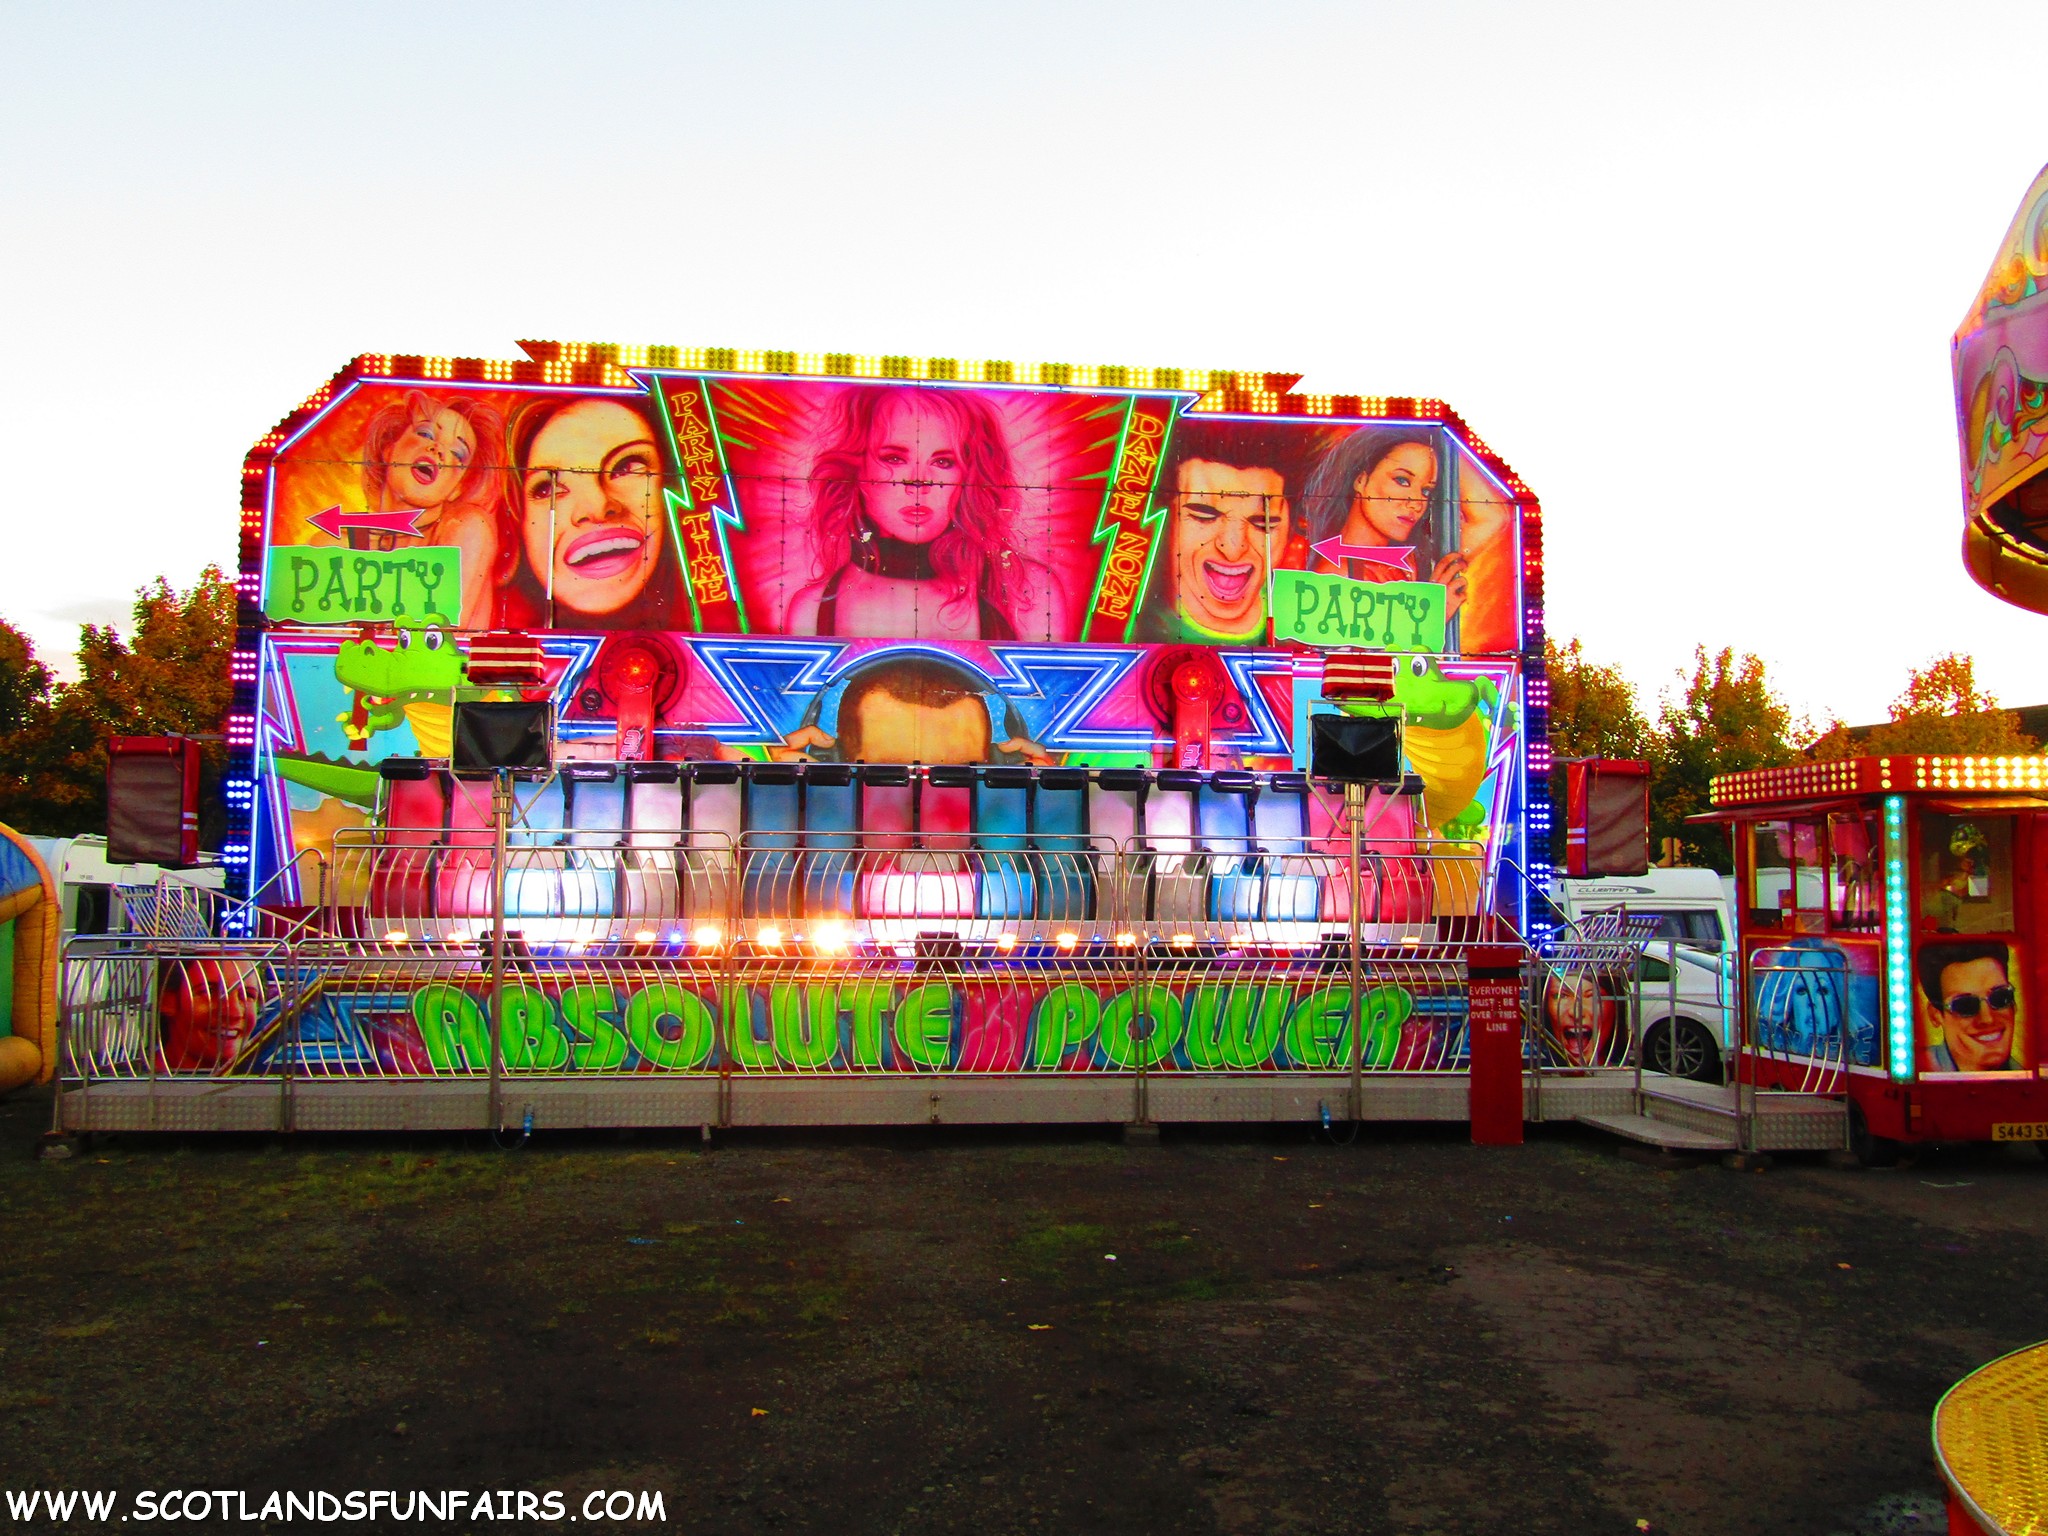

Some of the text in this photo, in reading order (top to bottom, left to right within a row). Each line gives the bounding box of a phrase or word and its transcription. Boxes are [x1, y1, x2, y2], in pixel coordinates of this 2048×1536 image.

[671, 391, 728, 604] PARTY TIME
[1097, 411, 1165, 620] DANCE ZONE
[291, 556, 445, 616] PARTY
[1293, 580, 1431, 645] PARTY
[413, 983, 1413, 1070] ABSOLUTE POWER
[1470, 1010, 1517, 1019] OVER THIS
[1471, 998, 1514, 1007] MUST BE
[1486, 1023, 1507, 1032] LINE
[1998, 1125, 2032, 1139] S443
